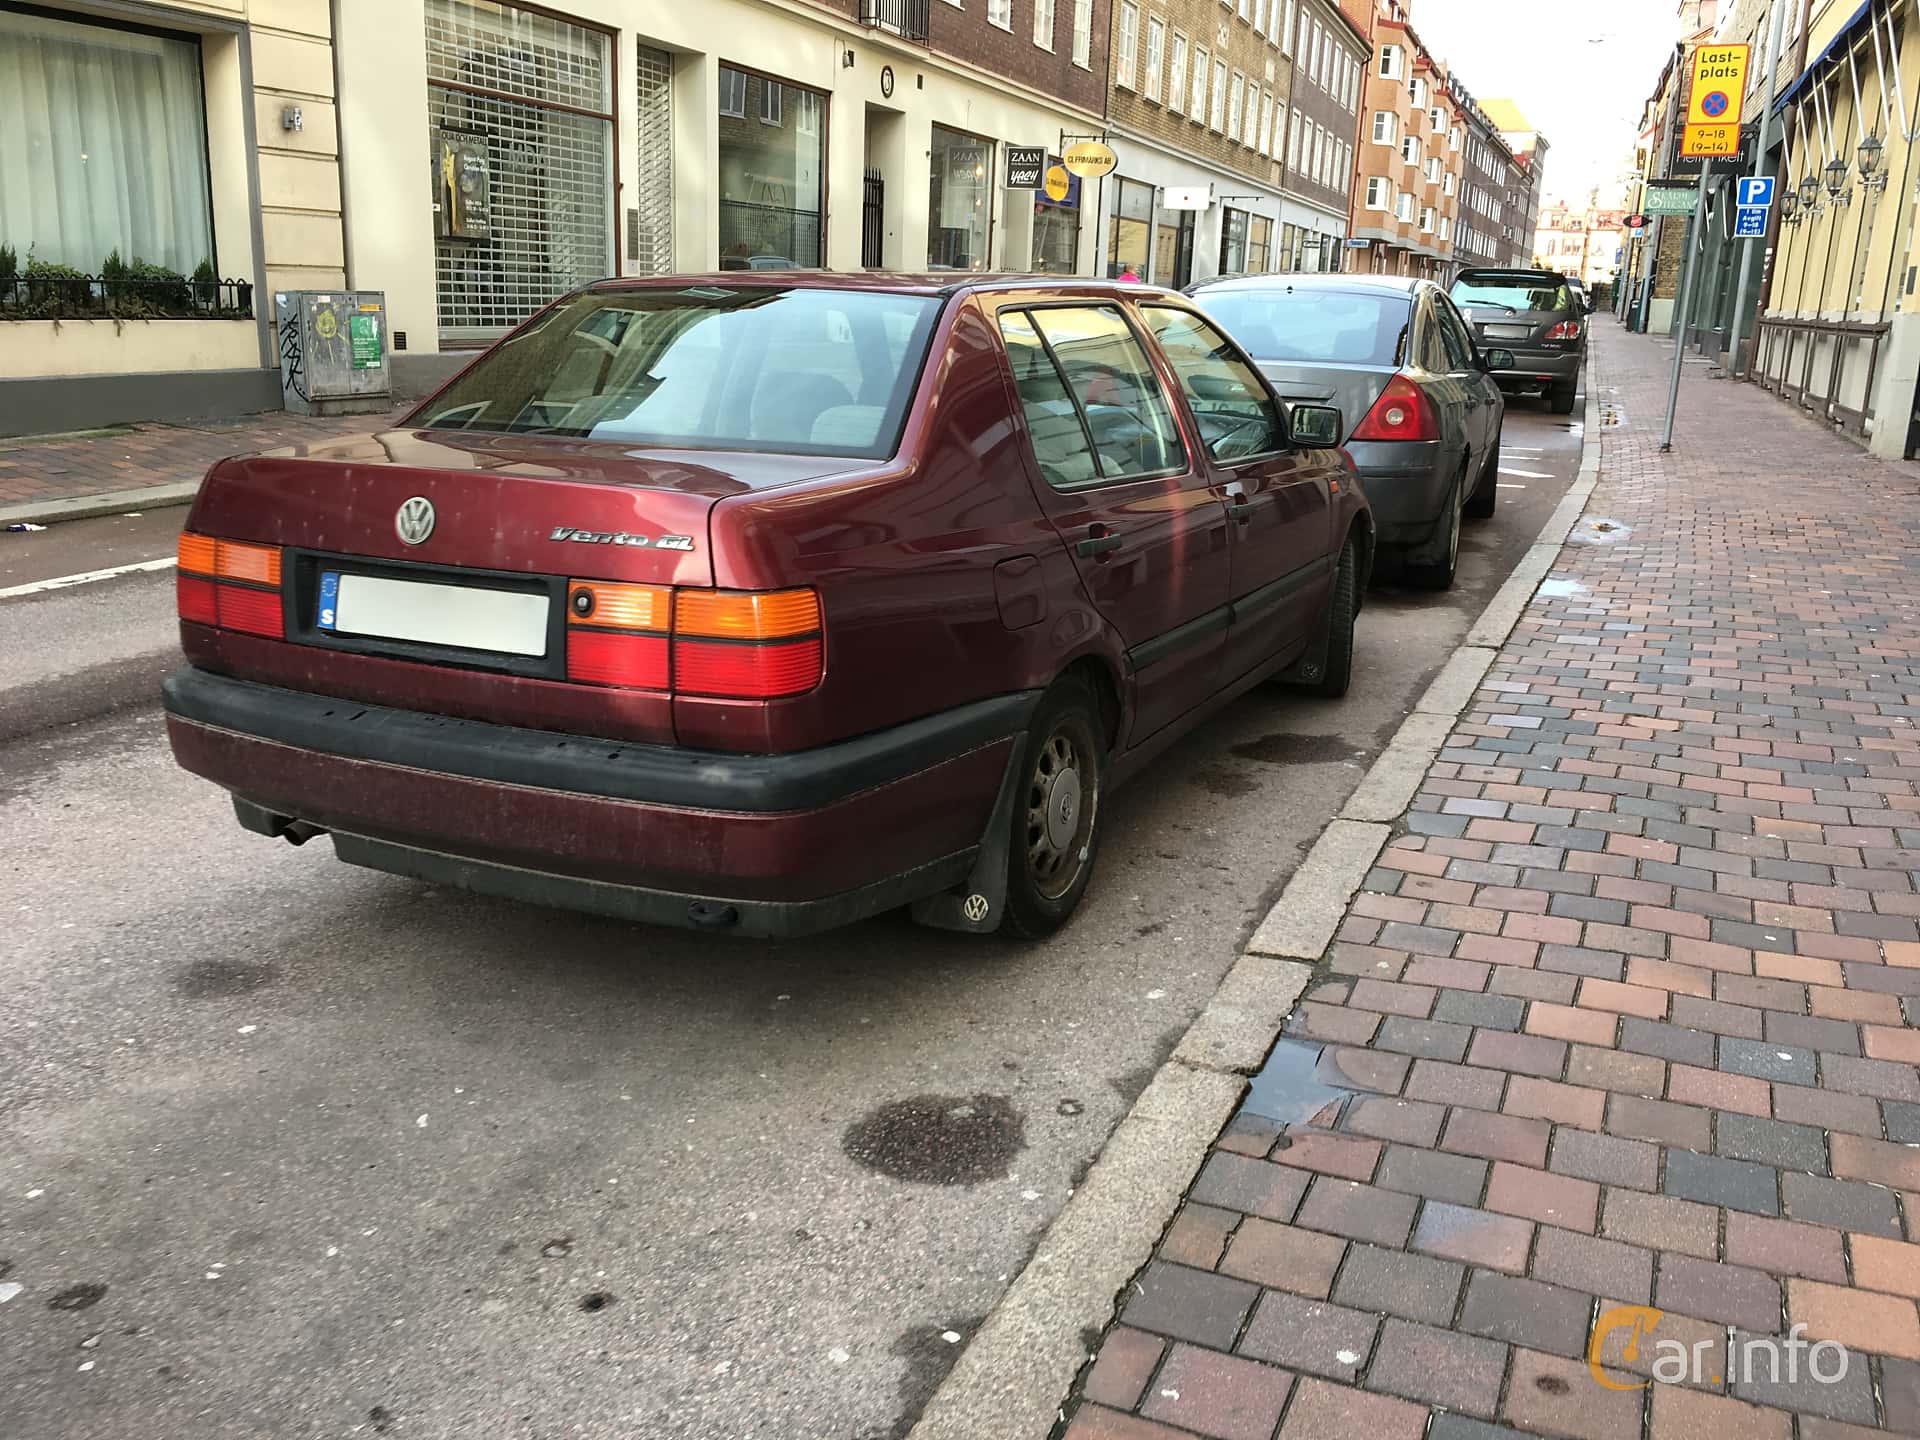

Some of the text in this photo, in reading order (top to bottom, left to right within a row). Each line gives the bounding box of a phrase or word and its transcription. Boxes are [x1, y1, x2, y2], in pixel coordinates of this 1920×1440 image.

[1700, 64, 1739, 81] plats
[1011, 152, 1040, 162] ZAAN
[1747, 180, 1766, 204] P
[549, 526, 695, 551] Vento GL
[320, 607, 334, 626] S
